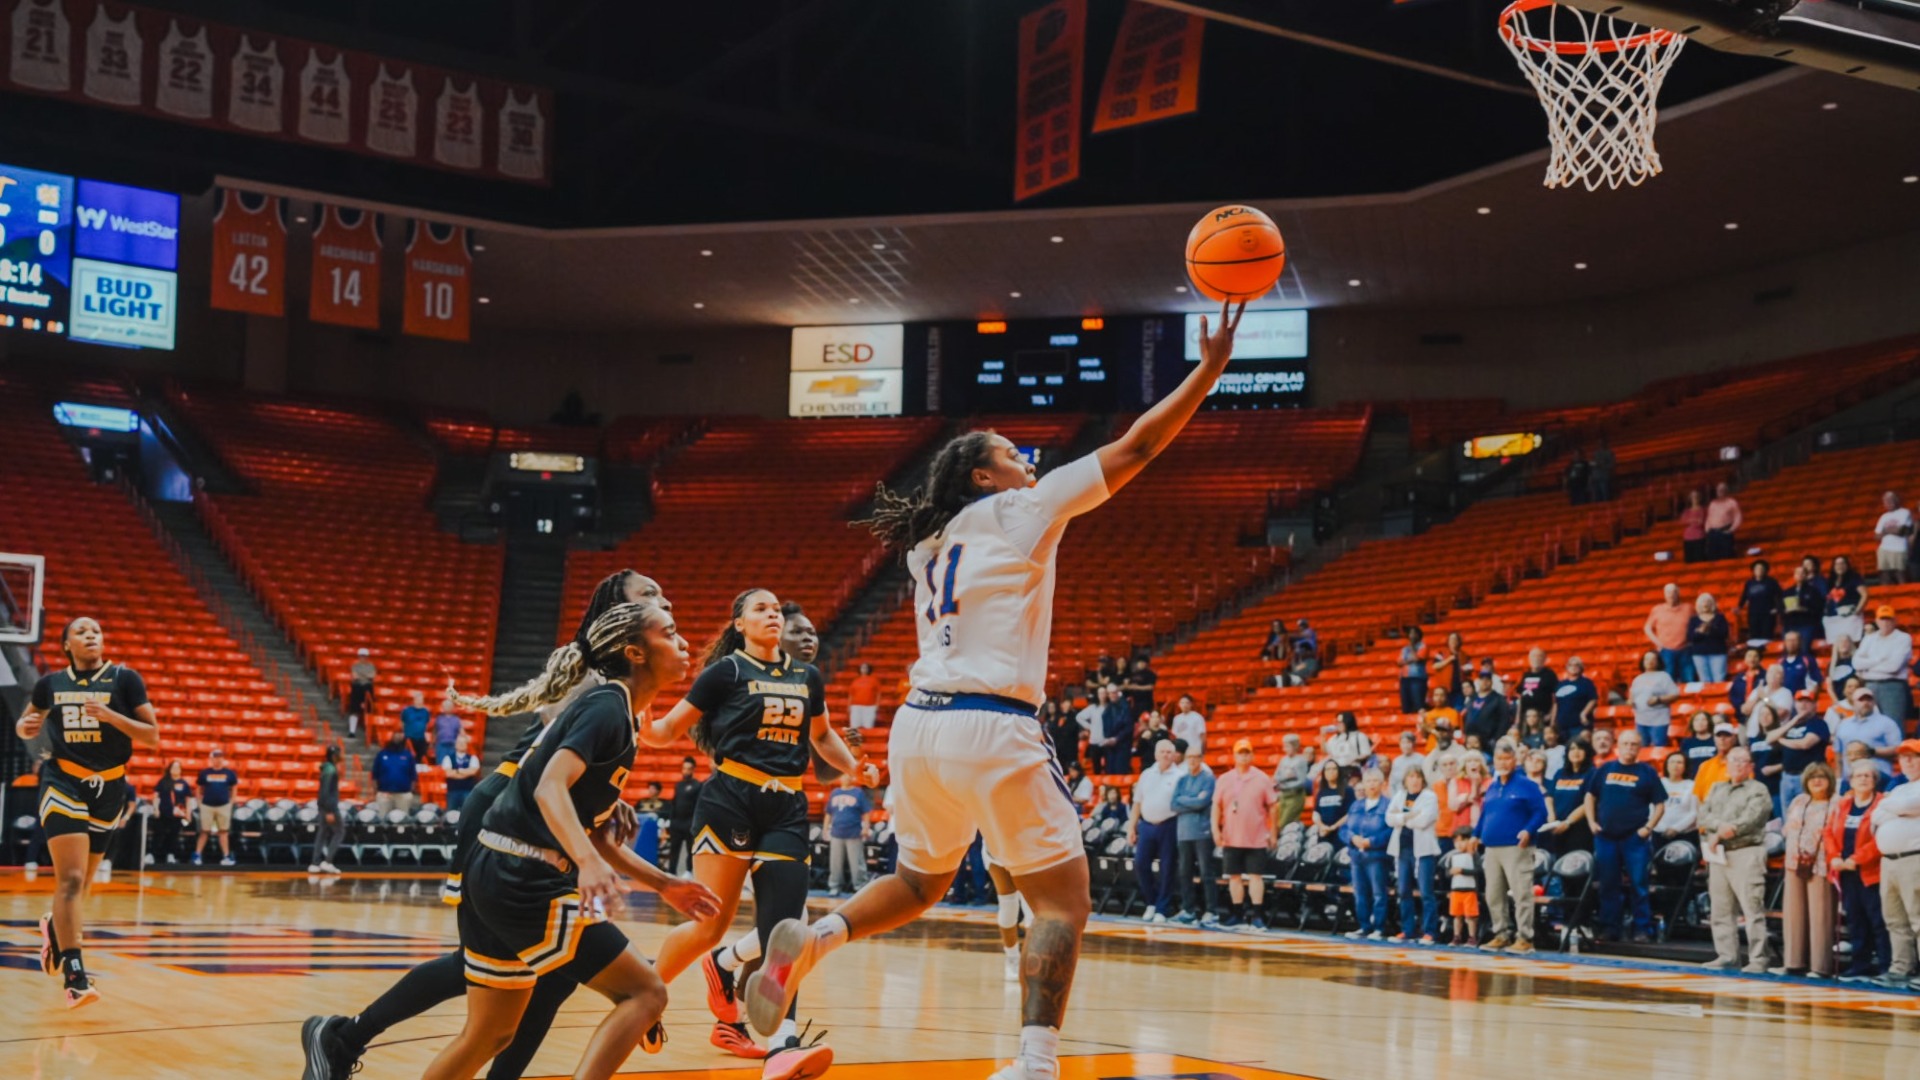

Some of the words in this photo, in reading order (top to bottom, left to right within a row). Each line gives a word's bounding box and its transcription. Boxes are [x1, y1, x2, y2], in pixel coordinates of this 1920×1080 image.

[26, 28, 55, 54] 21
[101, 46, 128, 70] 33
[171, 58, 201, 84] 22
[243, 72, 272, 98] 34
[310, 86, 339, 110] 44
[110, 214, 178, 240] WestStar
[1216, 207, 1255, 222] NCA
[38, 229, 56, 256] 0
[320, 245, 376, 264] ARCHIBALD
[229, 253, 269, 295] 42
[97, 277, 153, 300] BUD
[330, 267, 362, 308] 14
[84, 295, 163, 321] LIGHT
[422, 281, 454, 320] 10
[823, 344, 874, 363] ESD
[1220, 383, 1269, 394] INJURY
[1273, 382, 1304, 392] LAW
[1255, 371, 1304, 384] ORNELAS
[800, 402, 889, 415] CHEVROLET
[924, 543, 966, 626] 11
[762, 696, 804, 727] 23
[63, 730, 103, 743] STATE
[756, 727, 801, 745] STATE
